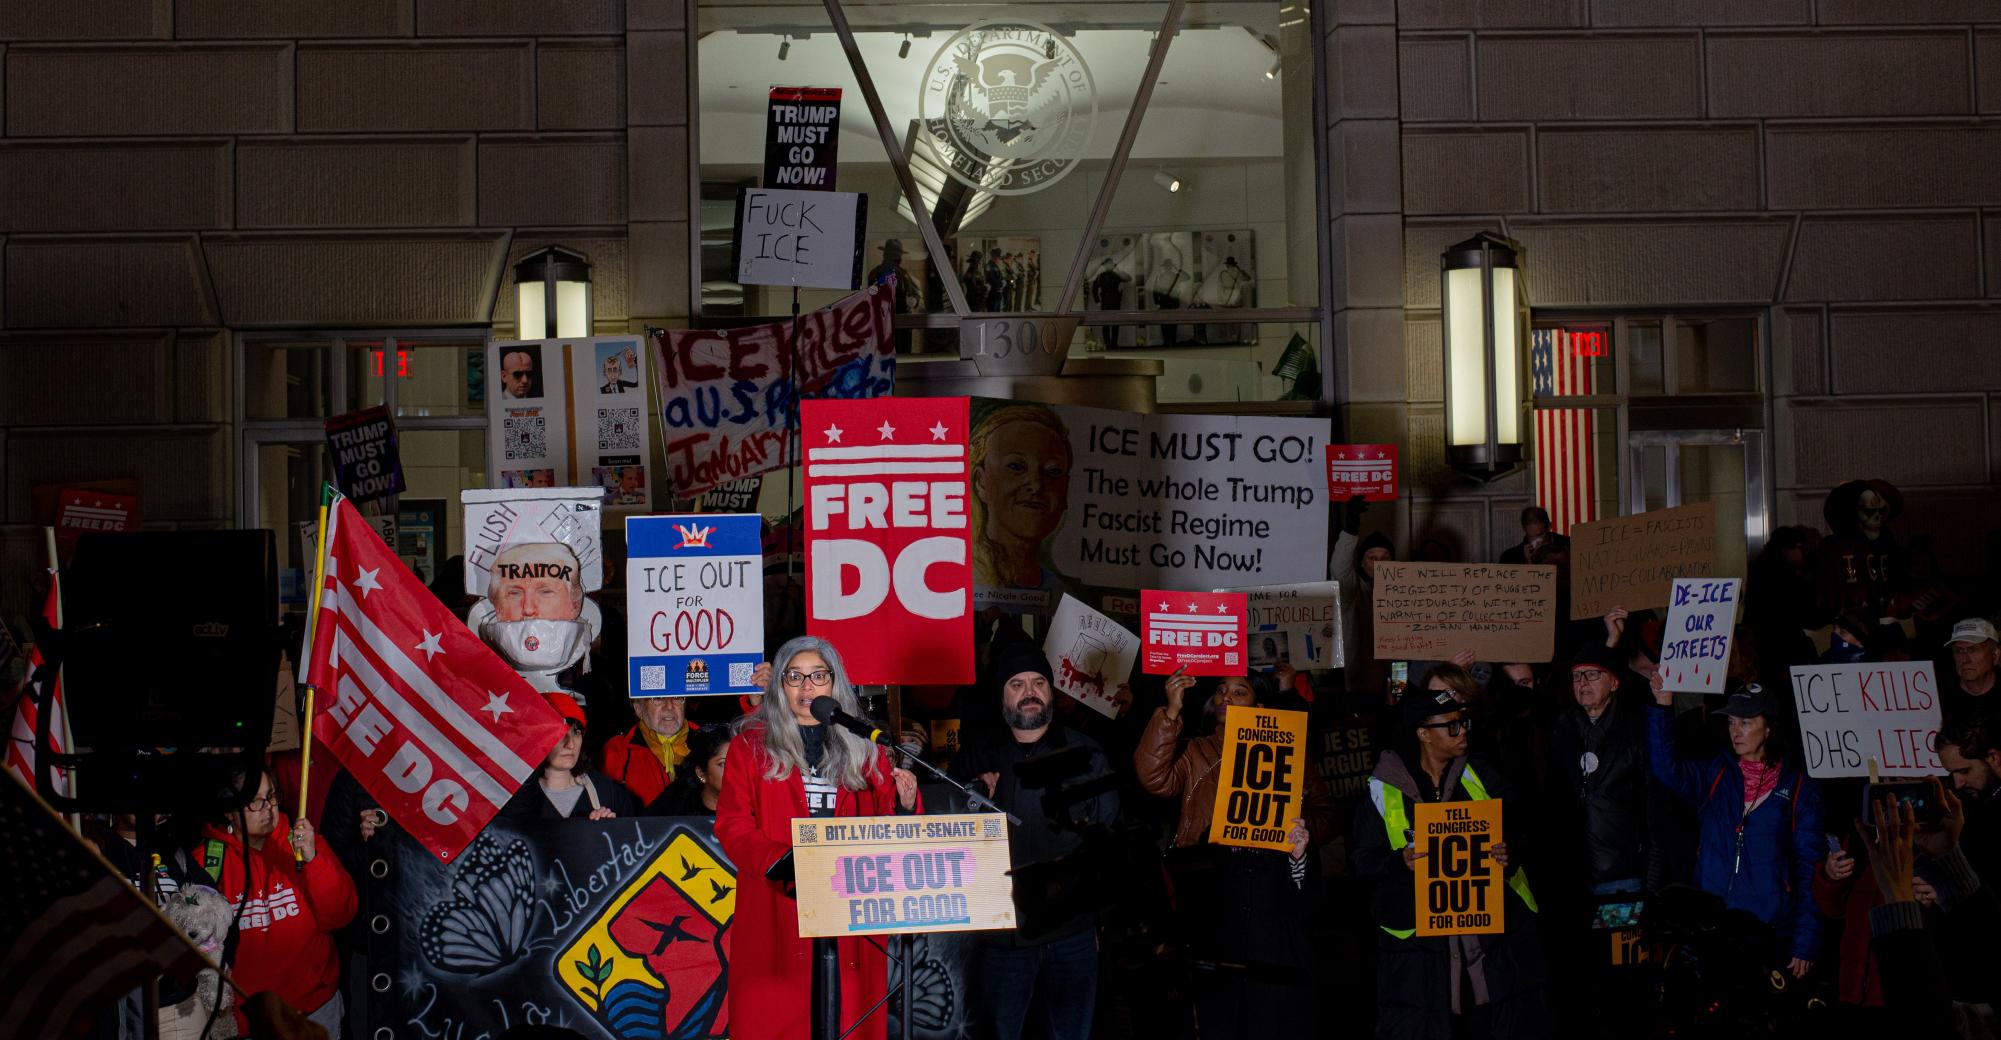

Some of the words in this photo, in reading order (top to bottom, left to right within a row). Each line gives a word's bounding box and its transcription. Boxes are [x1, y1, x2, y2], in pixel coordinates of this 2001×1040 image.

[930, 65, 953, 92] U.S.
[957, 27, 1074, 68] DEPARTMENT
[1069, 70, 1087, 93] OF
[772, 105, 837, 124] TRUMP
[777, 126, 829, 144] MUST
[788, 146, 815, 165] GO
[930, 118, 1013, 186] HOMELAND
[776, 166, 826, 185] NOW!
[747, 193, 824, 233] FUCK
[975, 321, 1058, 359] 1300
[656, 329, 770, 389] ICE
[665, 396, 694, 429] a
[693, 380, 760, 428] U.S.
[330, 420, 389, 449] TRUMP
[1089, 425, 1140, 456] ICE
[1150, 431, 1242, 462] MUST
[1253, 435, 1314, 464] GO!
[340, 440, 387, 465] MUST
[356, 459, 381, 478] GO
[1332, 471, 1368, 482] FREE
[1371, 470, 1393, 482] DC
[351, 472, 396, 498] NOW!
[1083, 468, 1129, 496] The
[1137, 475, 1219, 501] whole
[1226, 477, 1314, 510] Trump
[703, 492, 752, 509] MUST
[810, 481, 967, 531] FREE
[61, 516, 101, 530] FREE
[102, 520, 125, 532] DC
[1082, 504, 1162, 534] Fascist
[1171, 510, 1270, 540] Regime
[468, 501, 518, 573] FLUSH
[538, 503, 601, 570] FELON
[1080, 537, 1141, 566] Must
[1150, 544, 1186, 568] Go
[1194, 545, 1262, 573] Now!
[497, 563, 573, 581] TRAITOR
[643, 564, 686, 593] ICE
[700, 561, 752, 590] OUT
[811, 536, 966, 621] DC
[1418, 568, 1457, 577] WILL
[1464, 567, 1519, 579] REPLACE
[1527, 570, 1553, 579] THE
[676, 595, 703, 609] FOR
[1279, 590, 1298, 599] FOR
[1385, 584, 1467, 596] FRIGIDITY
[1471, 585, 1490, 595] OF
[1494, 584, 1541, 594] RUGGED
[1675, 582, 1733, 607] DE-ICE
[1261, 606, 1334, 625] TROUBLE
[1376, 598, 1477, 608] INDIVIDUALISM
[1483, 599, 1516, 608] WITH
[1526, 599, 1548, 607] THE
[1379, 610, 1432, 622] WARMTH
[1437, 611, 1457, 621] OF
[1685, 614, 1714, 632] OUR
[650, 608, 735, 652] GOOD
[1149, 630, 1202, 647] FREE
[1207, 632, 1239, 647] DC
[1664, 635, 1728, 660] STREETS
[1793, 672, 1850, 714] ICE
[1858, 670, 1933, 712] KILLS
[1255, 715, 1279, 729] TELL
[1237, 727, 1295, 744] CONGRESS:
[1806, 730, 1862, 769] DHS
[1878, 729, 1943, 769] LIES
[1232, 742, 1294, 792] ICE
[382, 739, 470, 826] DC
[1226, 790, 1291, 828] OUT
[1445, 808, 1471, 821] TELL
[825, 821, 976, 841] BIT.LY/ICE-OUT-SENATE
[1223, 825, 1248, 840] FOR
[1250, 828, 1286, 843] GOOD
[1428, 820, 1490, 835] CONGRESS:
[1428, 833, 1490, 878] ICE
[537, 821, 654, 935] Libertad
[843, 854, 894, 894] ICE
[902, 851, 965, 891] OUT
[1428, 879, 1490, 914] OUT
[238, 913, 271, 931] REE
[272, 902, 300, 921] DC
[850, 898, 897, 926] FOR
[902, 894, 968, 923] GOOD
[1429, 915, 1453, 929] FOR
[1457, 913, 1491, 928] GOOD
